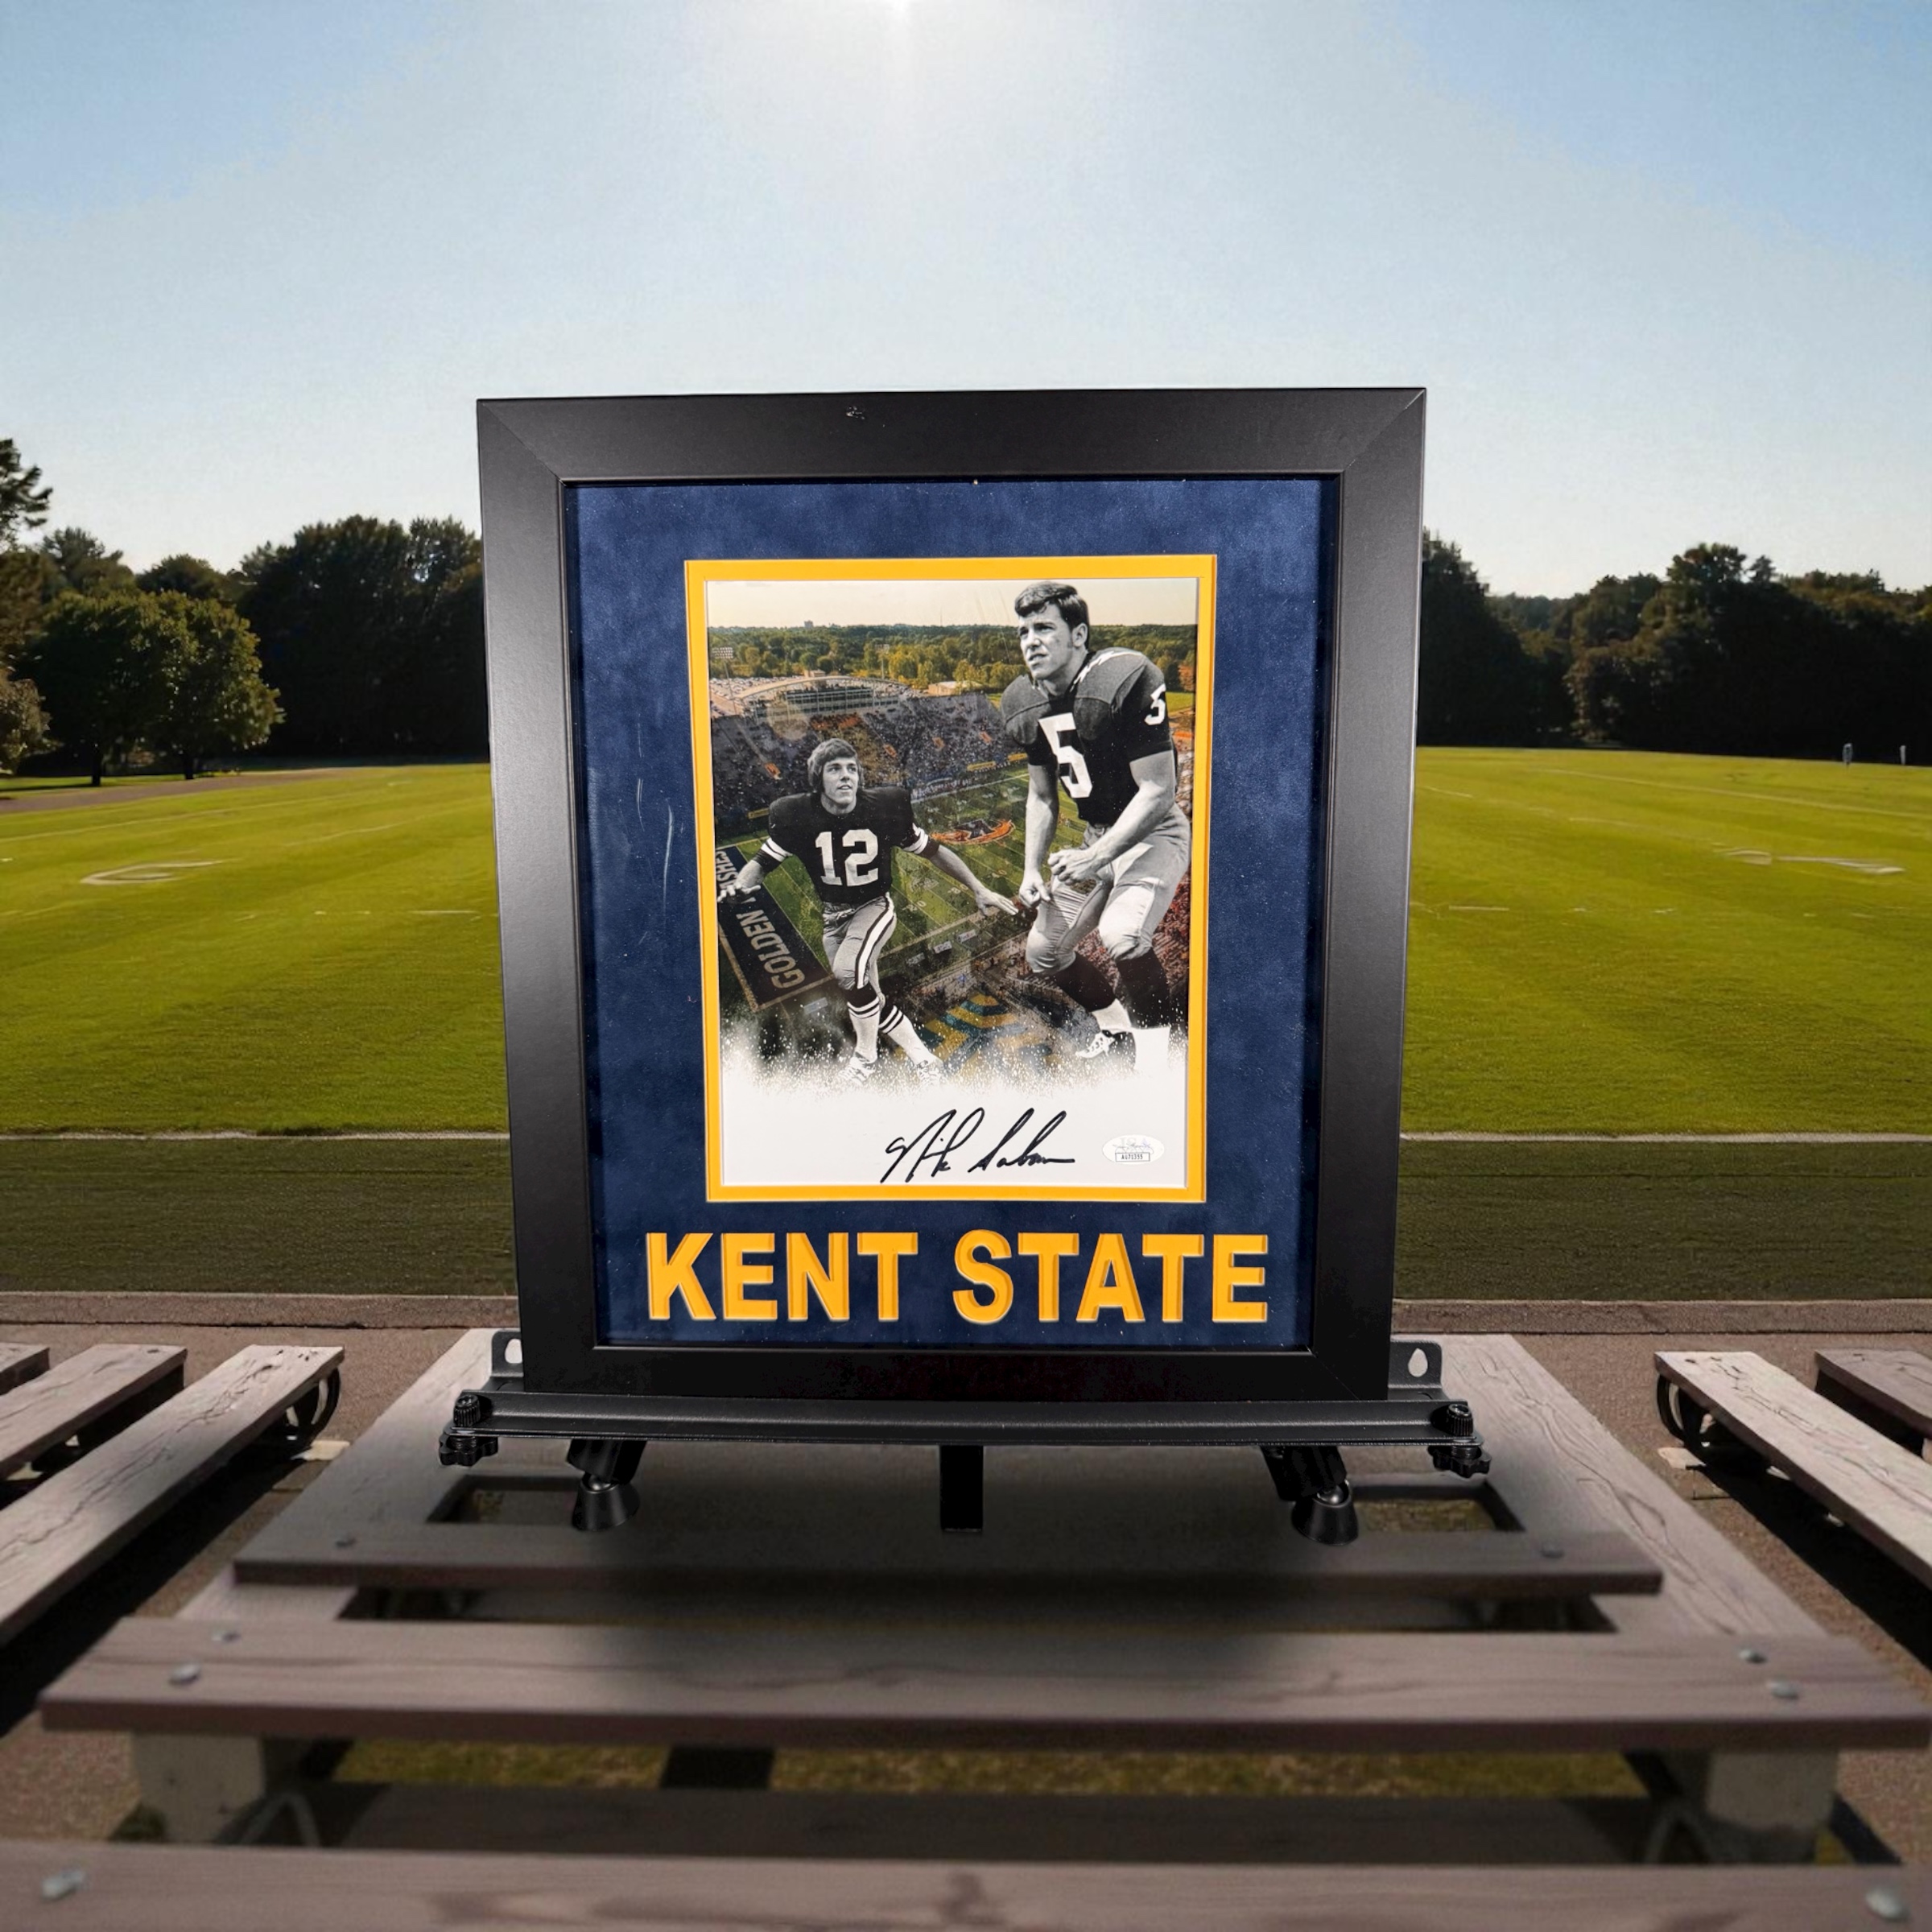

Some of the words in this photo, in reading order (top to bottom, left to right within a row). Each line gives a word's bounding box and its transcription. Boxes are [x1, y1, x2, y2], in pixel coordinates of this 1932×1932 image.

[1038, 712, 1093, 799] 5
[815, 828, 879, 887] 12
[736, 909, 805, 989] GOLDEN
[646, 1232, 919, 1320] KENT
[952, 1229, 1269, 1323] STATE
